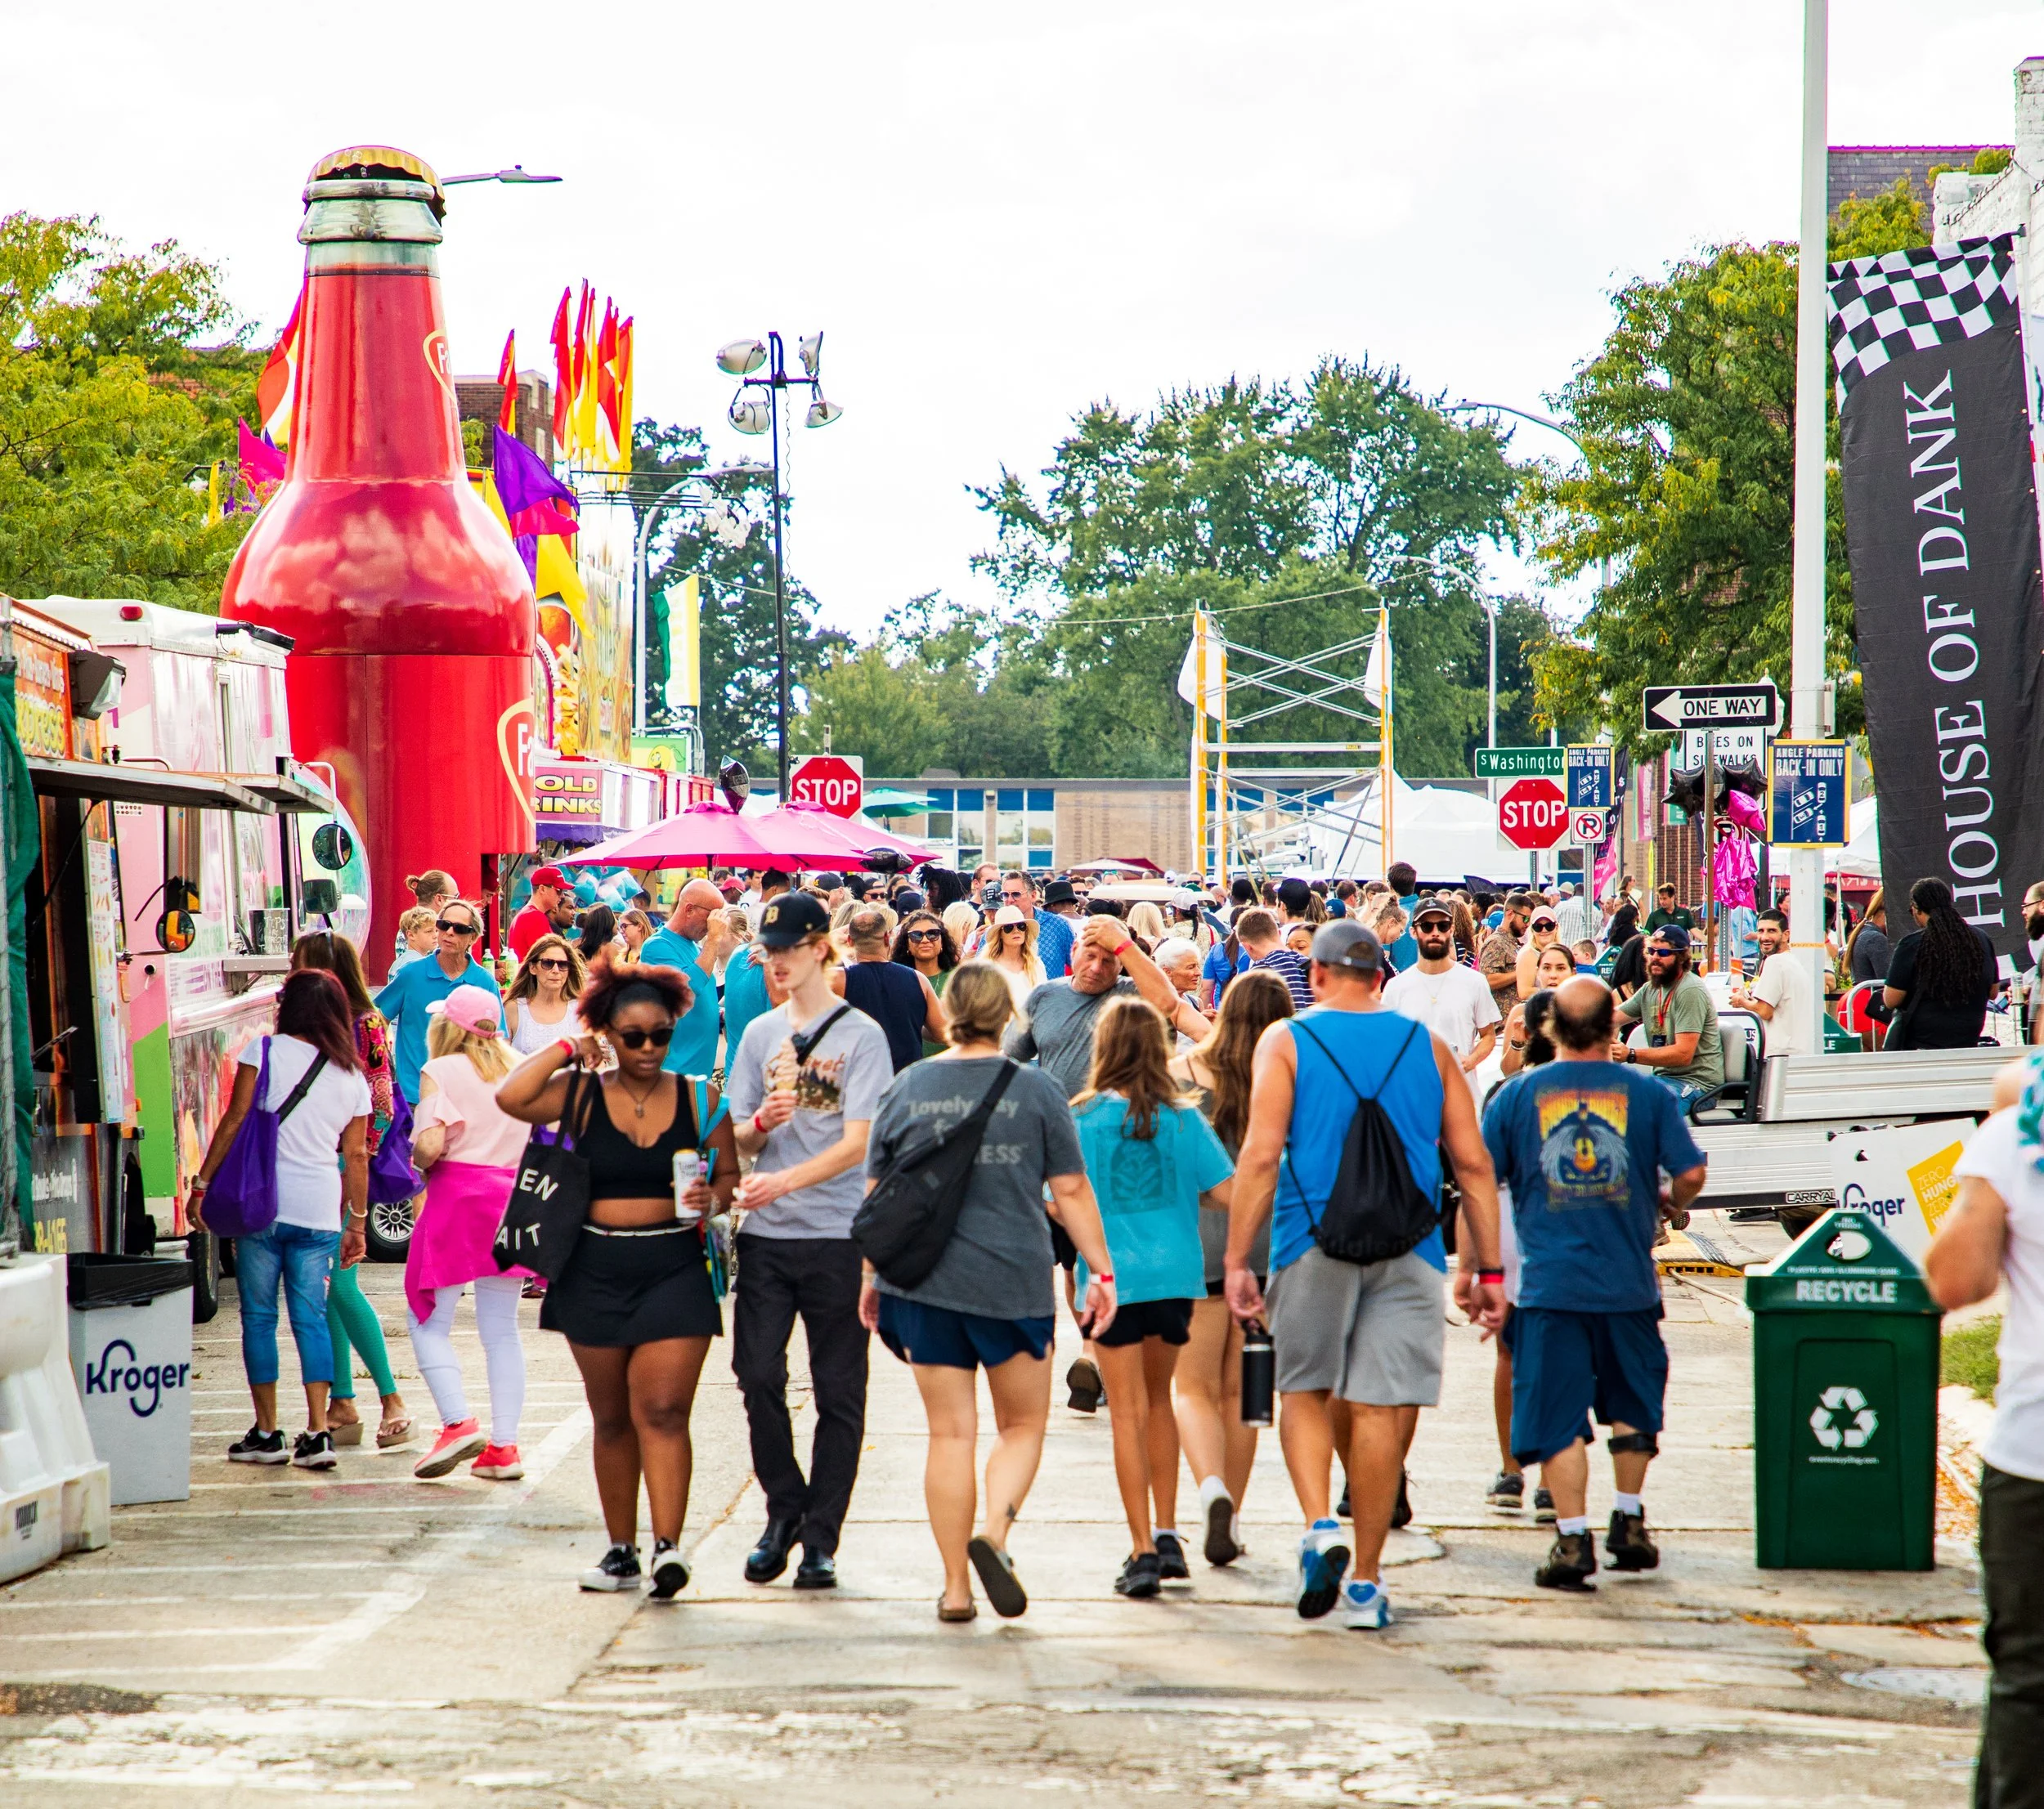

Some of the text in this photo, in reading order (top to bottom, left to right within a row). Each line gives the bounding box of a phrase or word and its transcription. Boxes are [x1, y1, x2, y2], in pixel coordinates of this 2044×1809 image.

[1903, 369, 2006, 928] HOUSE OF DANK
[1683, 698, 1761, 716] ONE WAY
[1697, 737, 1753, 748] BES ON
[1776, 748, 1844, 758] ANGLE PARKING
[1481, 754, 1487, 766] S
[1568, 755, 1610, 767] BACK-IN ONLY
[1693, 754, 1757, 766] SIEWALKS
[1775, 759, 1844, 777] BACK-IN ONLY
[796, 778, 858, 806] STOP
[1503, 800, 1566, 828] STOP
[1916, 1166, 1946, 1191] ZERO
[1921, 1175, 1959, 1203] HUNG
[1796, 1280, 1898, 1304] RECYCLE
[86, 1339, 191, 1417] Kroger
